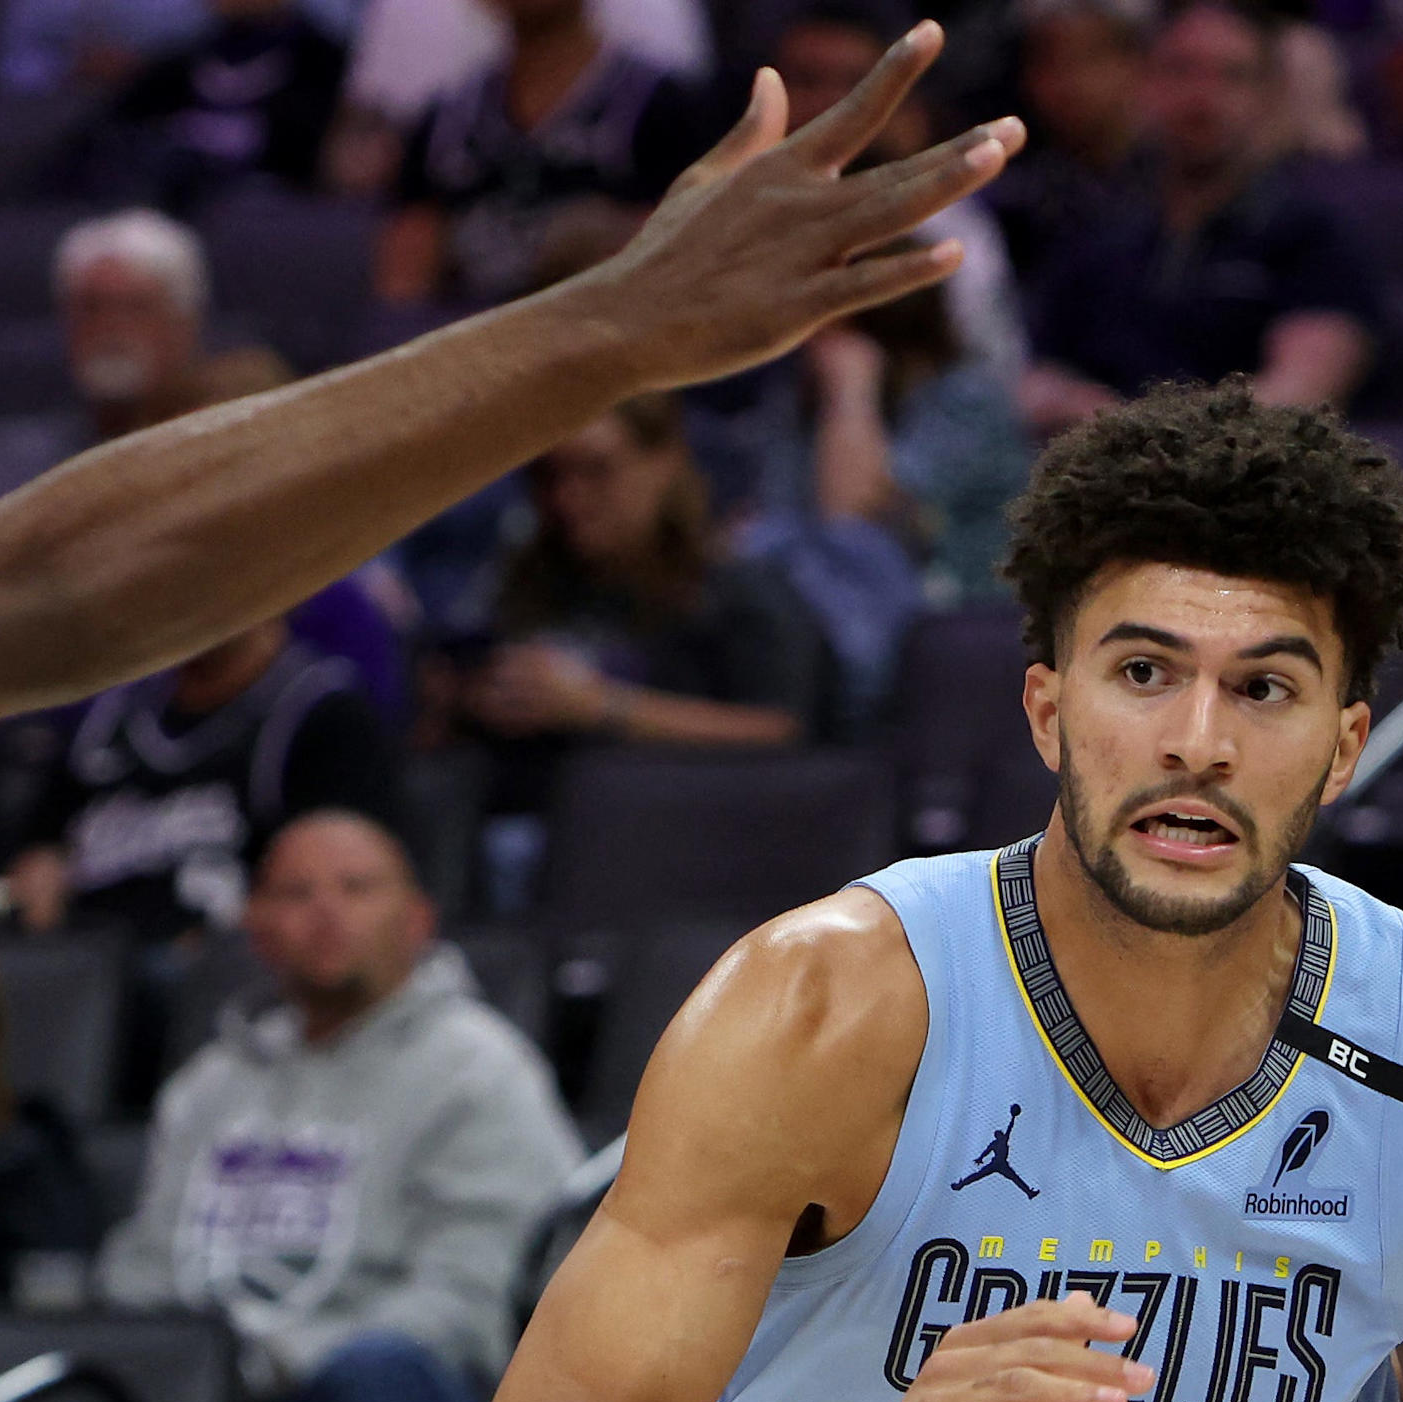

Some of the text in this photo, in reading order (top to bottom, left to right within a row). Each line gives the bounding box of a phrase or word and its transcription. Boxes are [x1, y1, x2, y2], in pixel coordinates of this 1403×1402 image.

[1327, 1038, 1371, 1080] BC
[1244, 1192, 1349, 1217] Robinhood
[978, 1236, 1289, 1278] MEMPHIS
